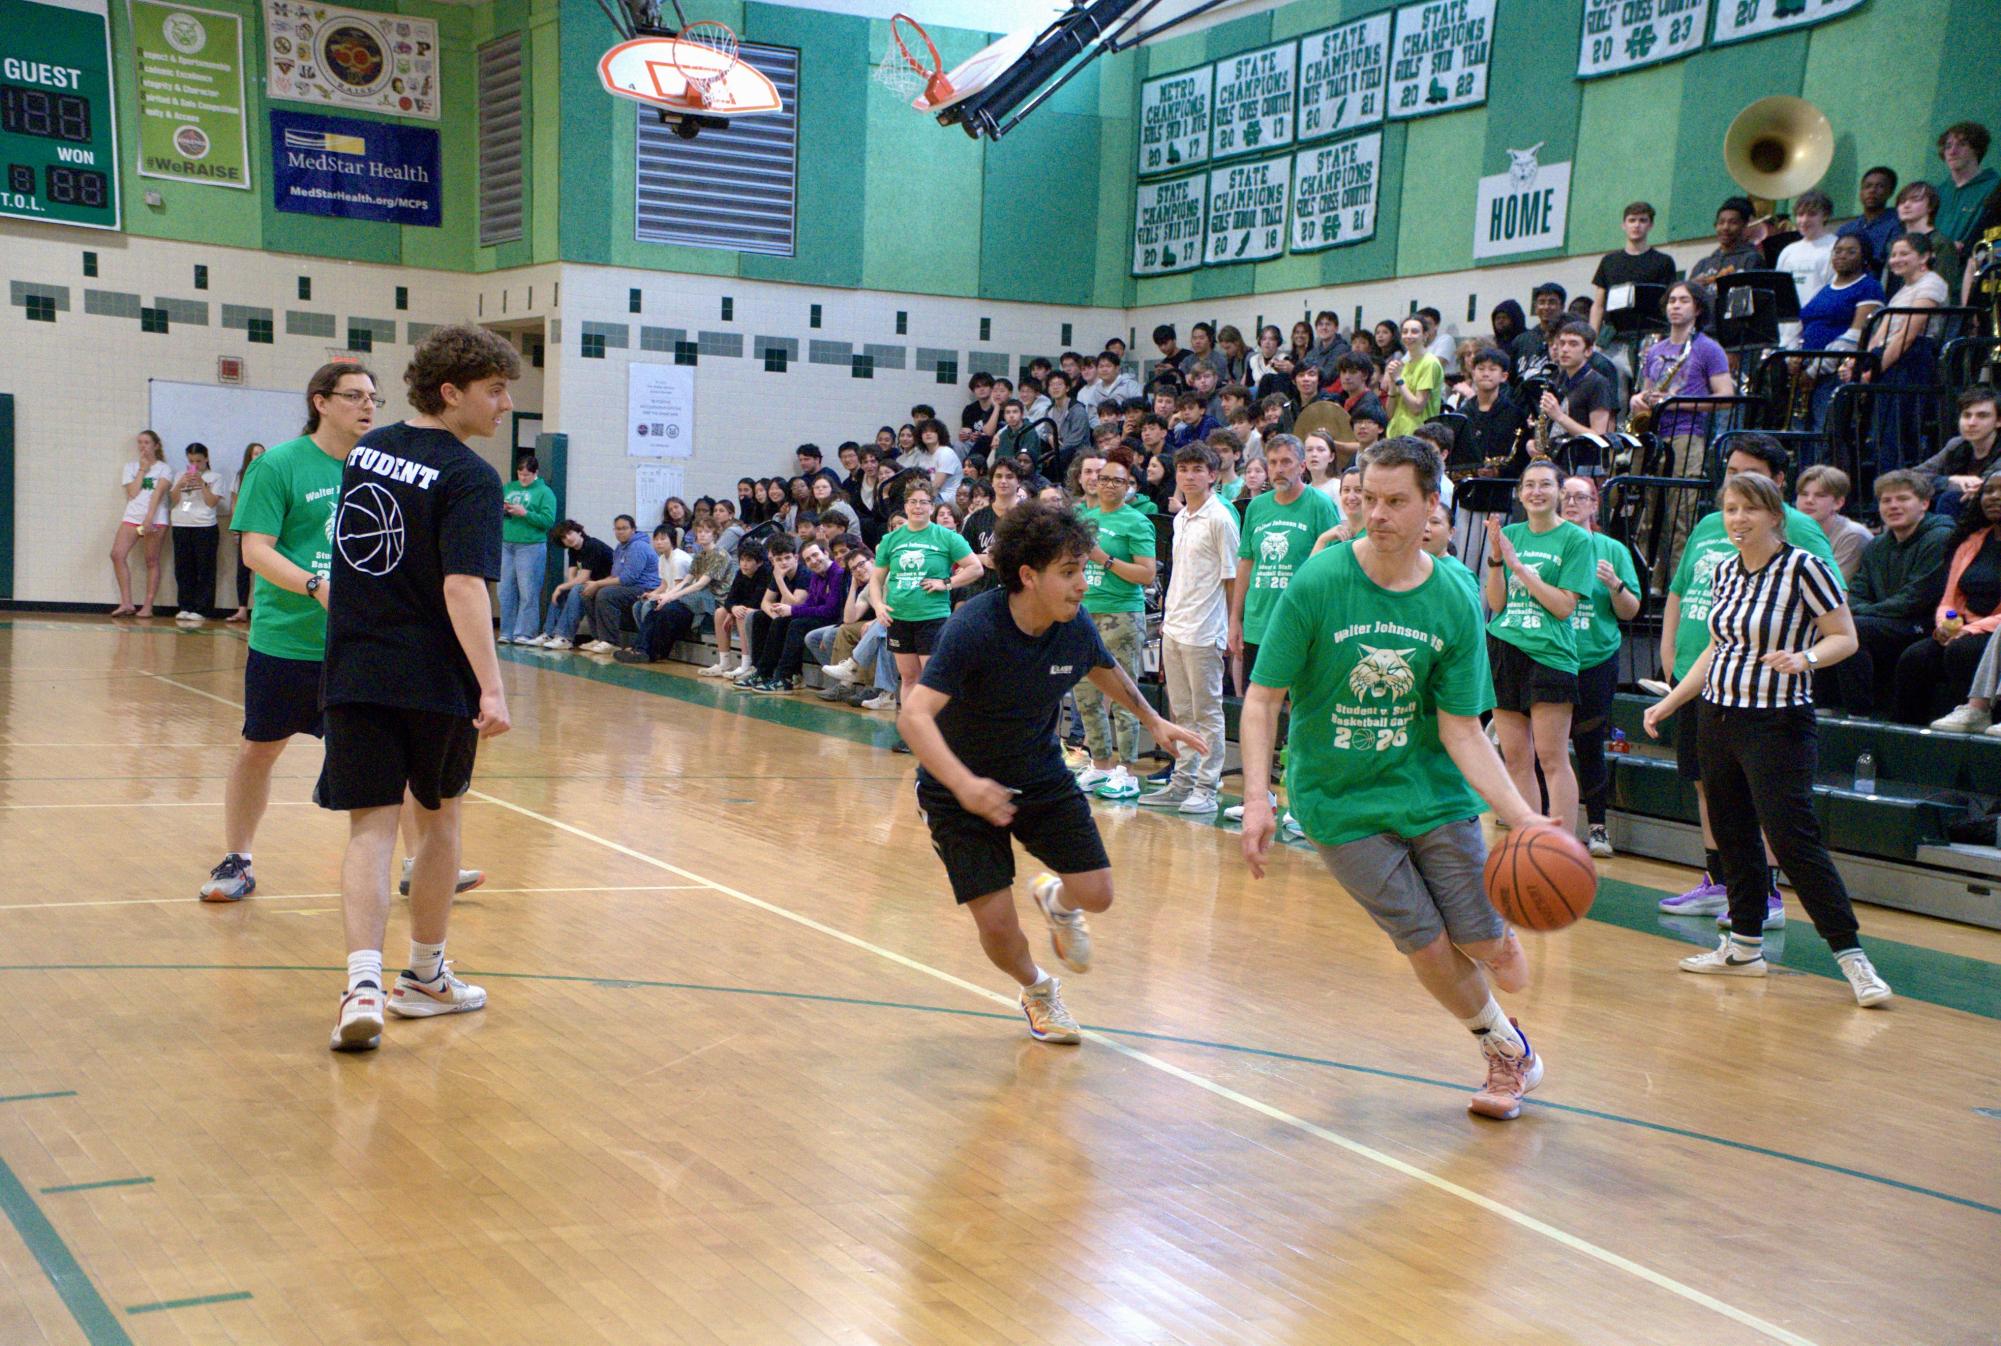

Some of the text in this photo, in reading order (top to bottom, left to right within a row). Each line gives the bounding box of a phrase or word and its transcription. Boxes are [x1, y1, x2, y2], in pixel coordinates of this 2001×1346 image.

[1422, 0, 1468, 30] STATE
[1734, 0, 1758, 28] 20
[1322, 23, 1367, 57] STATE
[1402, 17, 1486, 57] CHAMPIONS
[1593, 35, 1613, 64] 20
[1669, 14, 1693, 45] 23
[4, 57, 82, 89] GUEST
[1235, 51, 1276, 80] STATE
[1305, 43, 1381, 84] CHAMPIONS
[1160, 77, 1195, 103] METRO
[1220, 70, 1289, 105] CHAMPIONS
[1401, 72, 1474, 107] 20 22
[1146, 94, 1206, 125] CHAMPIONS
[1306, 92, 1375, 131] 20 21
[1220, 128, 1235, 149] 20
[1273, 116, 1284, 139] 17
[57, 146, 94, 165] WON
[145, 156, 240, 179] #WeRAISE
[288, 152, 429, 183] MedStar Health
[1148, 138, 1200, 168] 20 17
[1317, 142, 1358, 173] STATE
[1157, 181, 1189, 204] STATE
[1229, 165, 1270, 190] STATE
[1300, 160, 1373, 197] CHAMPIONS
[0, 192, 46, 212] T.O.L.
[290, 186, 429, 210] MedStarHealth.org/MCPS
[1143, 198, 1199, 226] CHAMPIONS
[1214, 183, 1284, 213] CHAMPIONS
[1301, 221, 1316, 242] 20
[1353, 209, 1365, 232] 21
[1489, 188, 1554, 242] HOME
[1143, 241, 1194, 267] 20 17
[1214, 235, 1228, 256] 20
[346, 446, 440, 490] TUDENT
[305, 487, 335, 503] Walter
[1688, 604, 1708, 621] 26
[1334, 624, 1372, 644] Walter
[1374, 621, 1428, 642] Johnson
[1331, 712, 1387, 728] Basketball
[1336, 703, 1377, 716] Student
